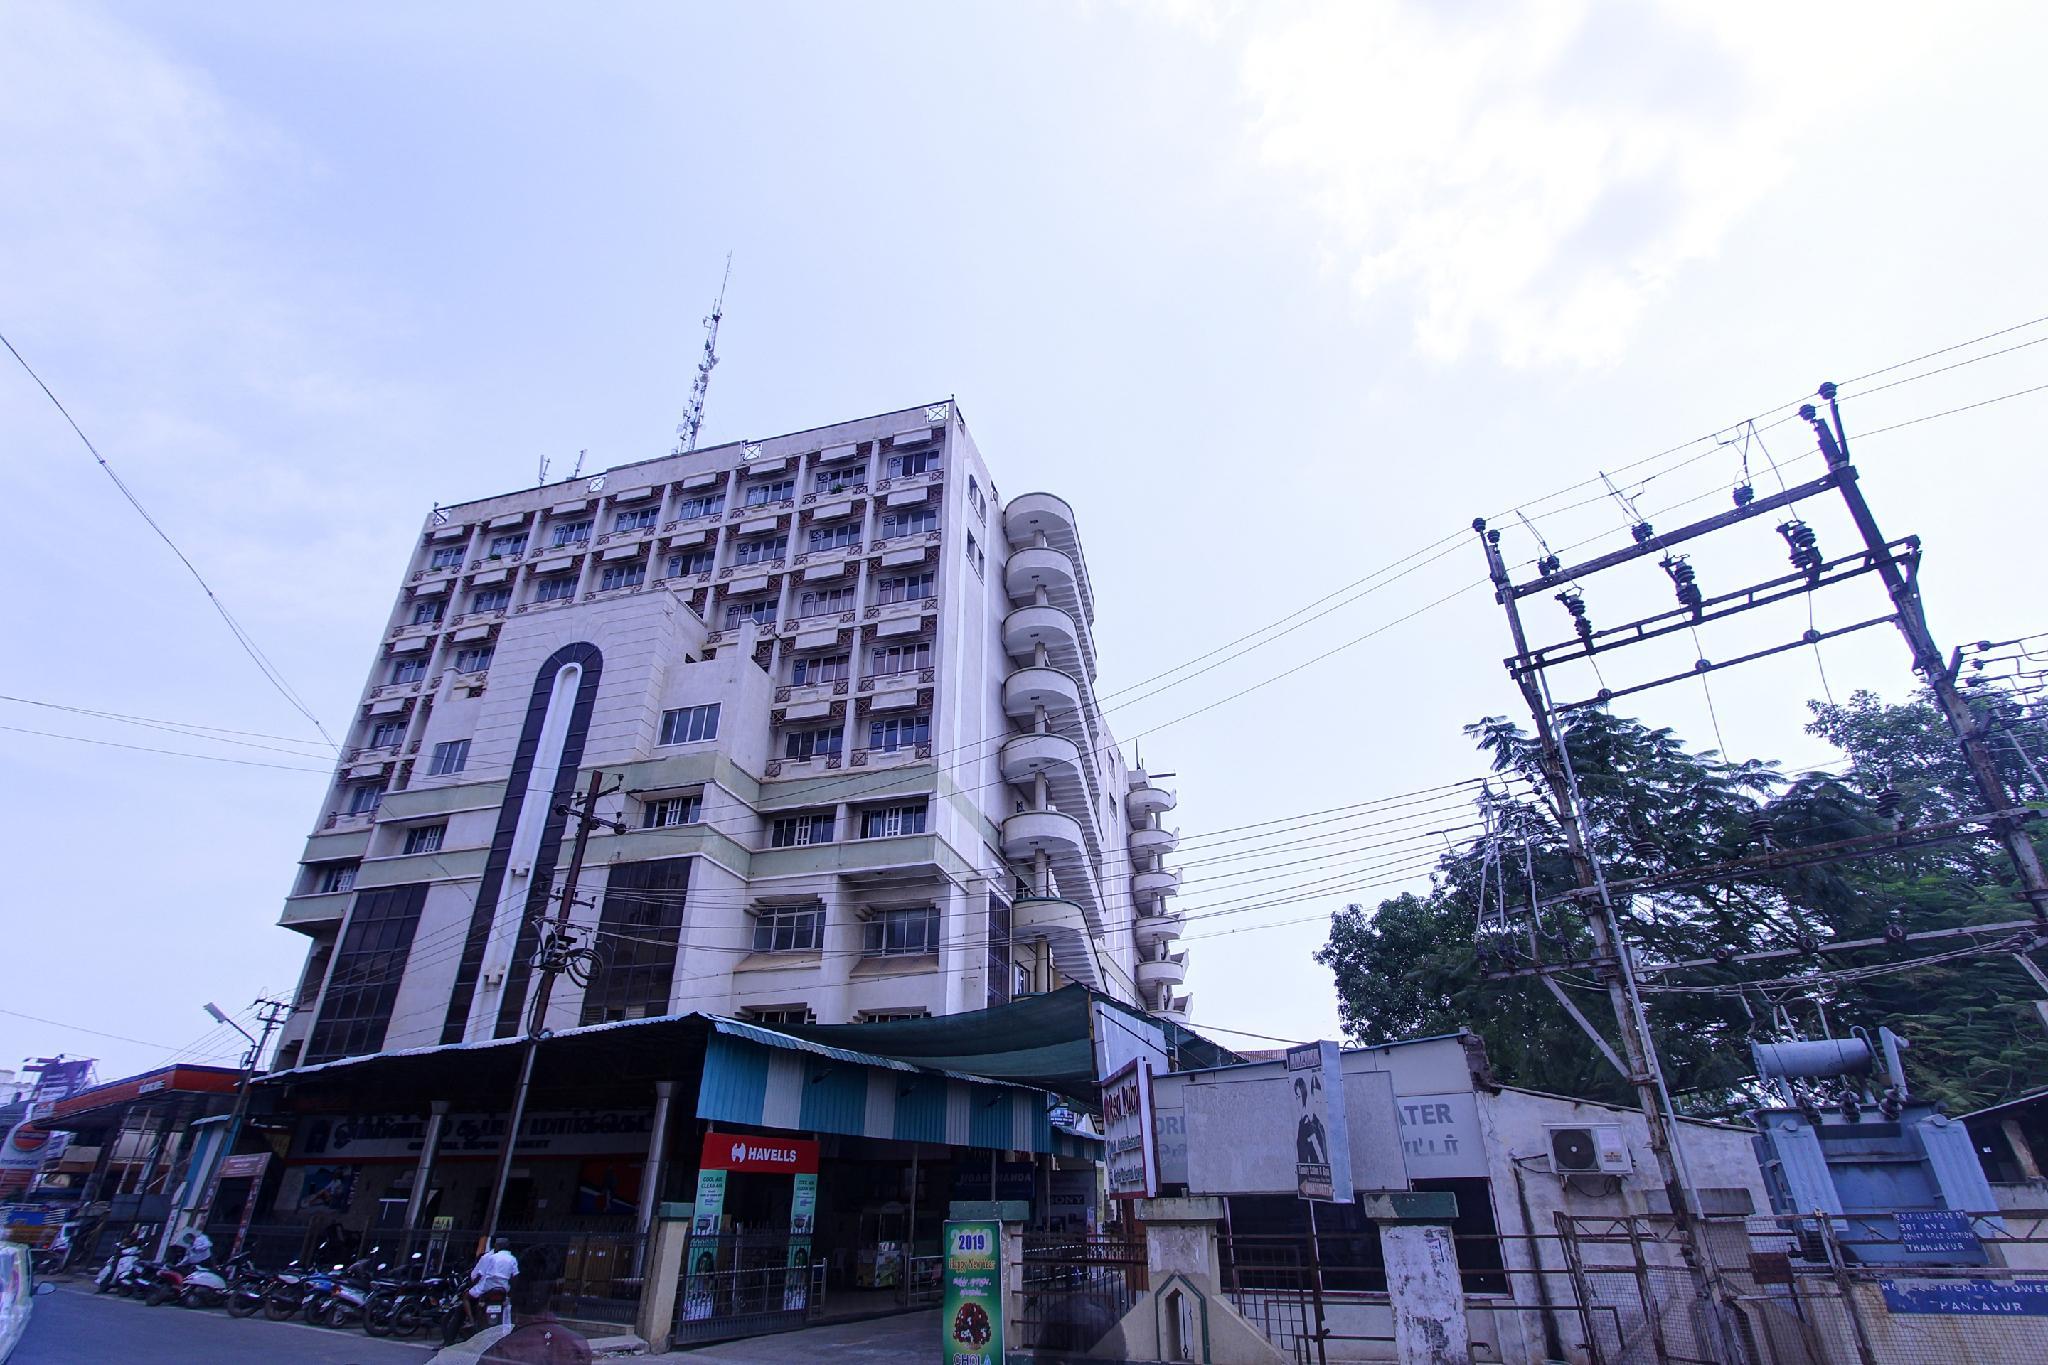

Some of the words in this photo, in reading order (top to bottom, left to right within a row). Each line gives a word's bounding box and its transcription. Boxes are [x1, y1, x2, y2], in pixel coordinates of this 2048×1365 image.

[748, 1146, 797, 1163] HAVELLS
[959, 1234, 985, 1250] 2019
[1905, 1242, 1965, 1252] THANJAVUR
